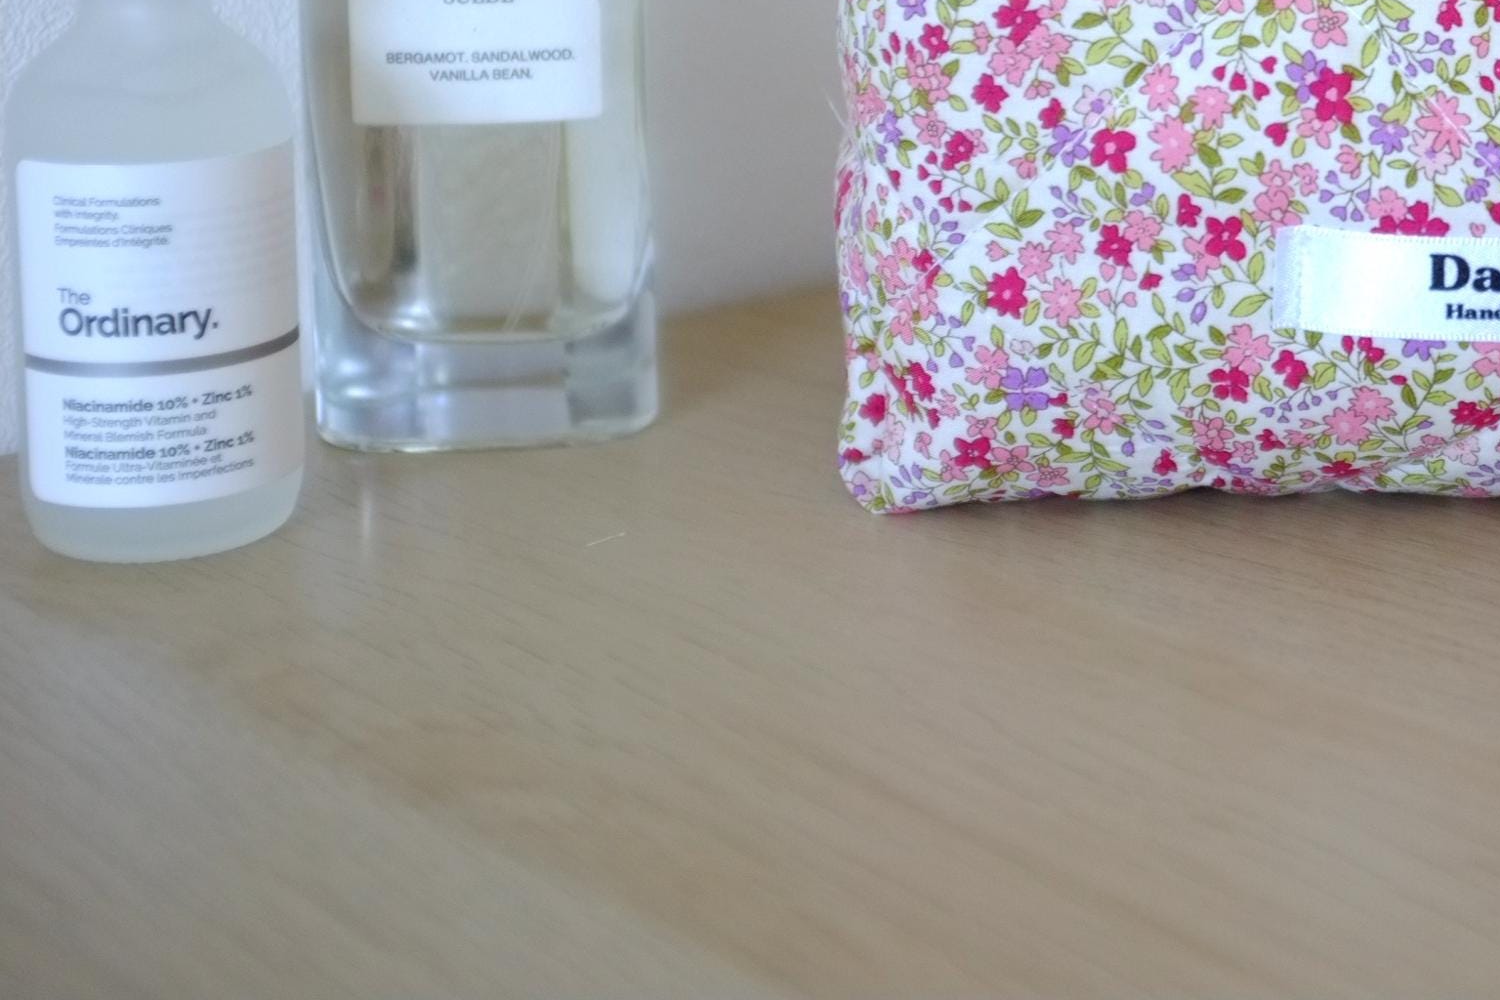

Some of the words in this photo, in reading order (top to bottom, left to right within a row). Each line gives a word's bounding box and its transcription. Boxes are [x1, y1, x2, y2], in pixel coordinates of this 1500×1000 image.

[429, 69, 489, 81] VANILLA
[57, 288, 90, 306] The
[59, 307, 218, 340] Ordinary.
[63, 400, 153, 413] Niacinamide
[157, 396, 188, 411] 10%
[202, 391, 232, 406] Zinc
[234, 385, 253, 399] 1%
[64, 415, 142, 430] High-Strength
[144, 412, 193, 426] Vitamin
[195, 408, 217, 420] and
[64, 430, 104, 443] Mineral
[107, 429, 154, 443] Blemish
[157, 426, 207, 441] Formula
[65, 447, 155, 461] Niacinamide
[159, 443, 190, 458] 10%
[204, 438, 234, 454] Zinc
[237, 431, 256, 446] 1%
[118, 471, 155, 484] contre
